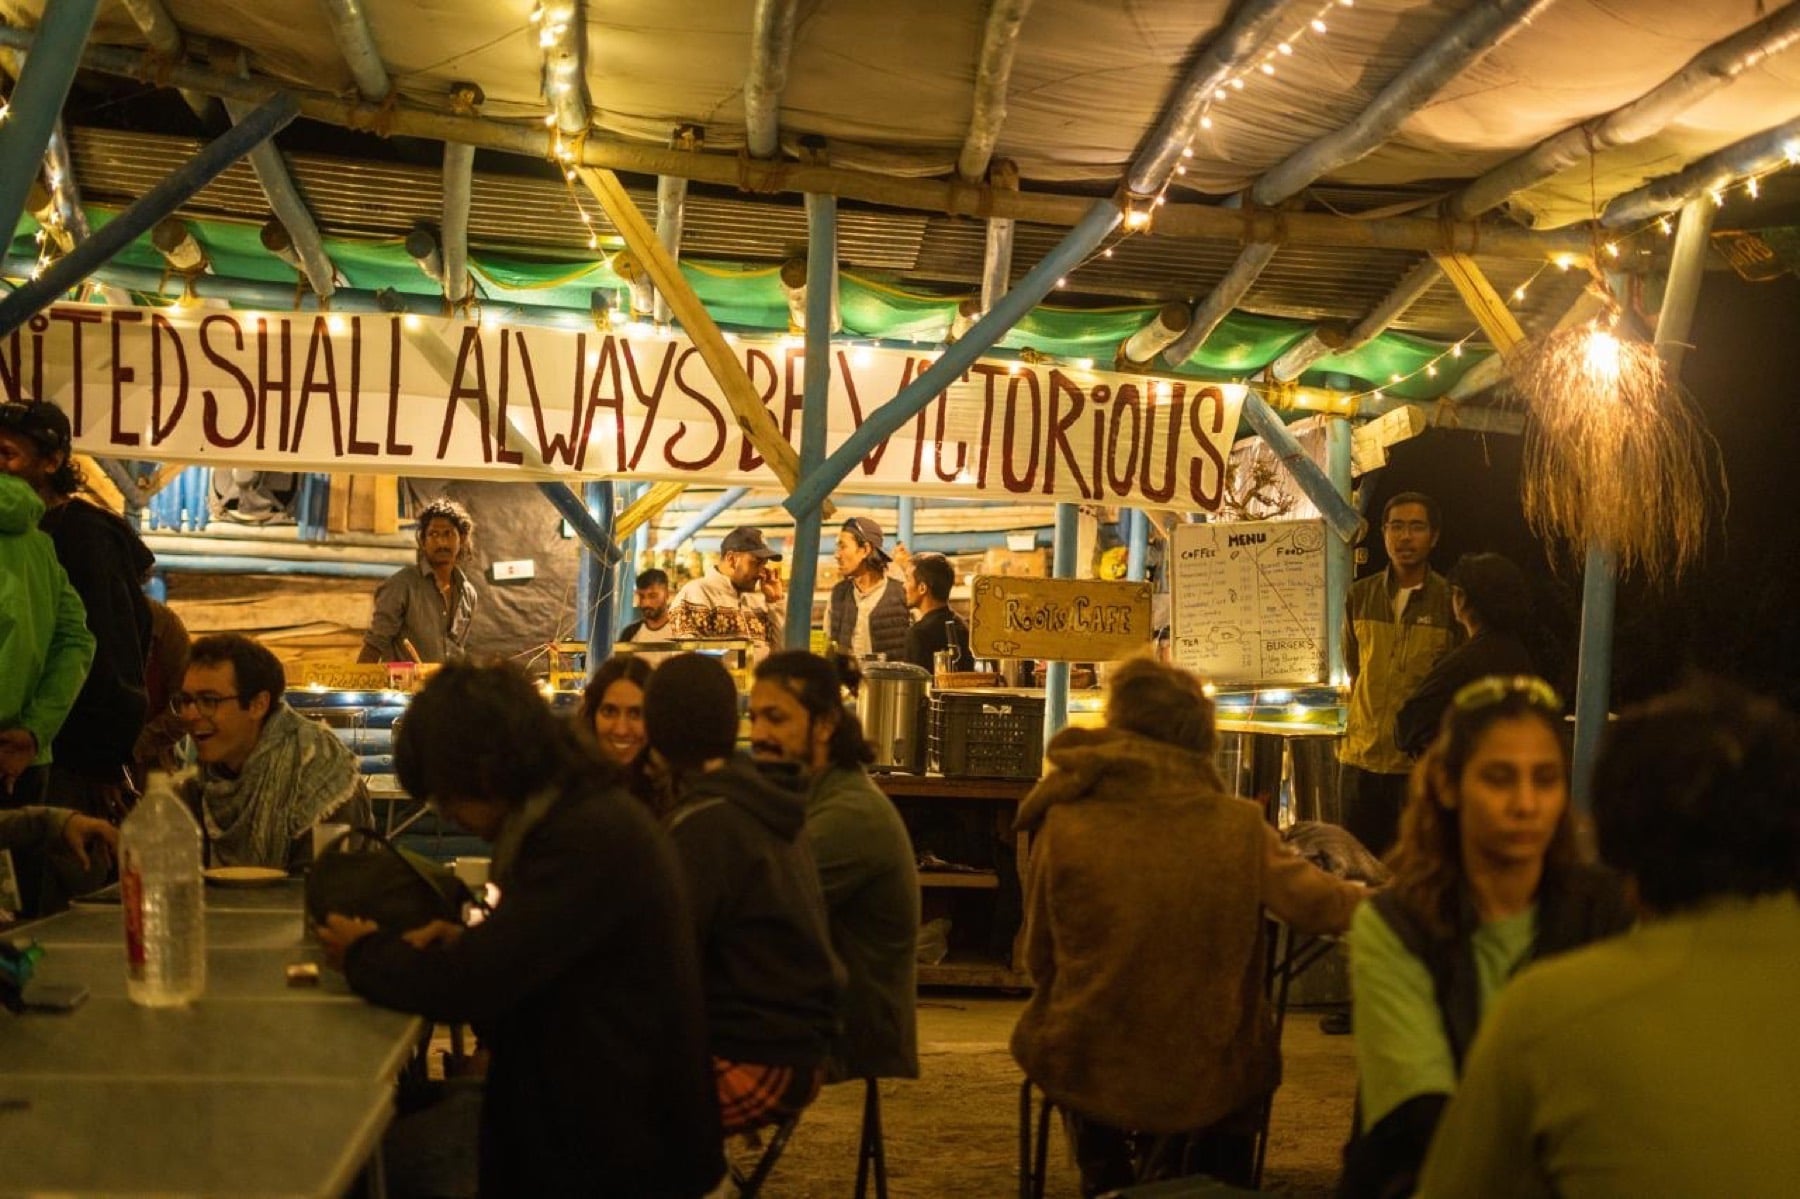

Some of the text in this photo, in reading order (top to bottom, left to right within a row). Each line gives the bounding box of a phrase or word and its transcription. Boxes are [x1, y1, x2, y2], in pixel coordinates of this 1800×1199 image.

[200, 314, 413, 457] SHALL
[437, 325, 727, 473] ALWAYS
[1228, 533, 1267, 547] MENU
[1073, 596, 1132, 634] CAFE
